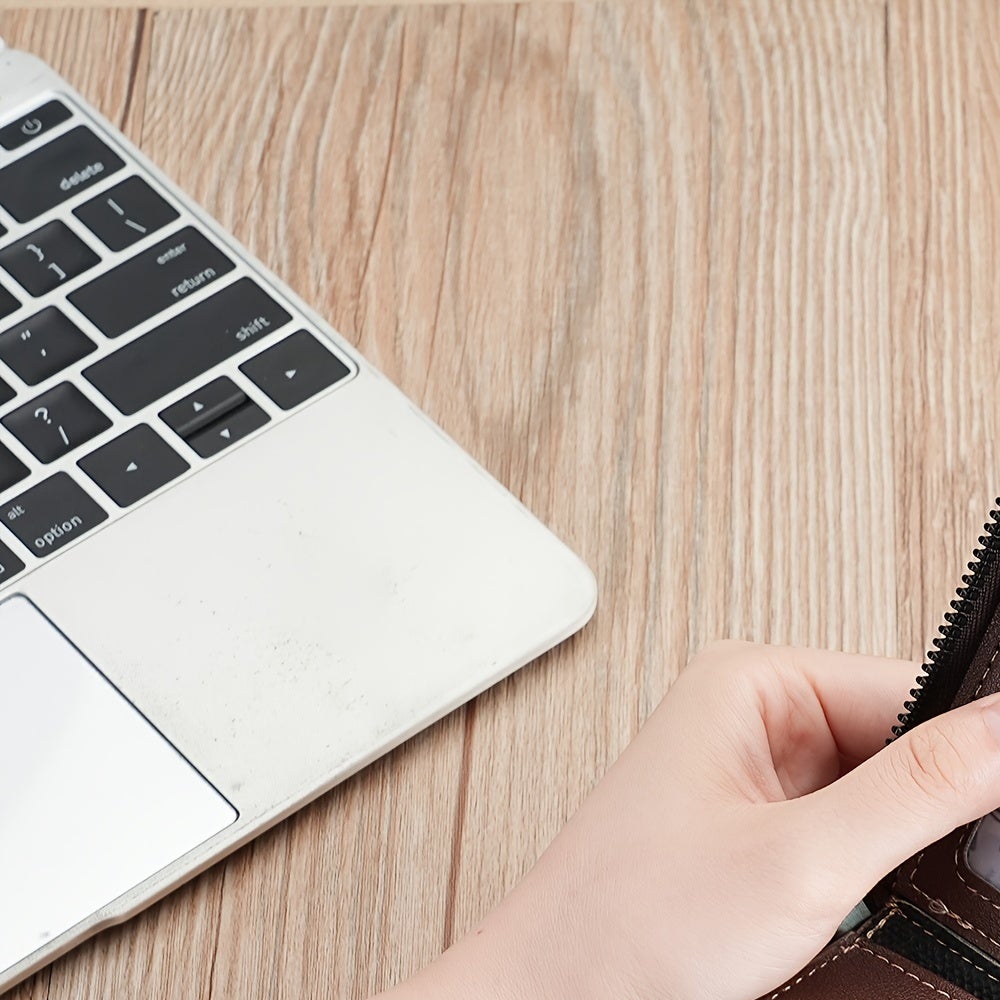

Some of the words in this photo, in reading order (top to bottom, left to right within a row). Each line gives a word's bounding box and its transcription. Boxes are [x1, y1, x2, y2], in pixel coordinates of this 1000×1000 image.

[60, 162, 104, 190] delete
[157, 243, 187, 265] enter
[171, 268, 216, 297] return
[235, 317, 270, 341] shift
[34, 407, 51, 424] ?
[7, 506, 25, 520] alt
[35, 515, 82, 548] option
